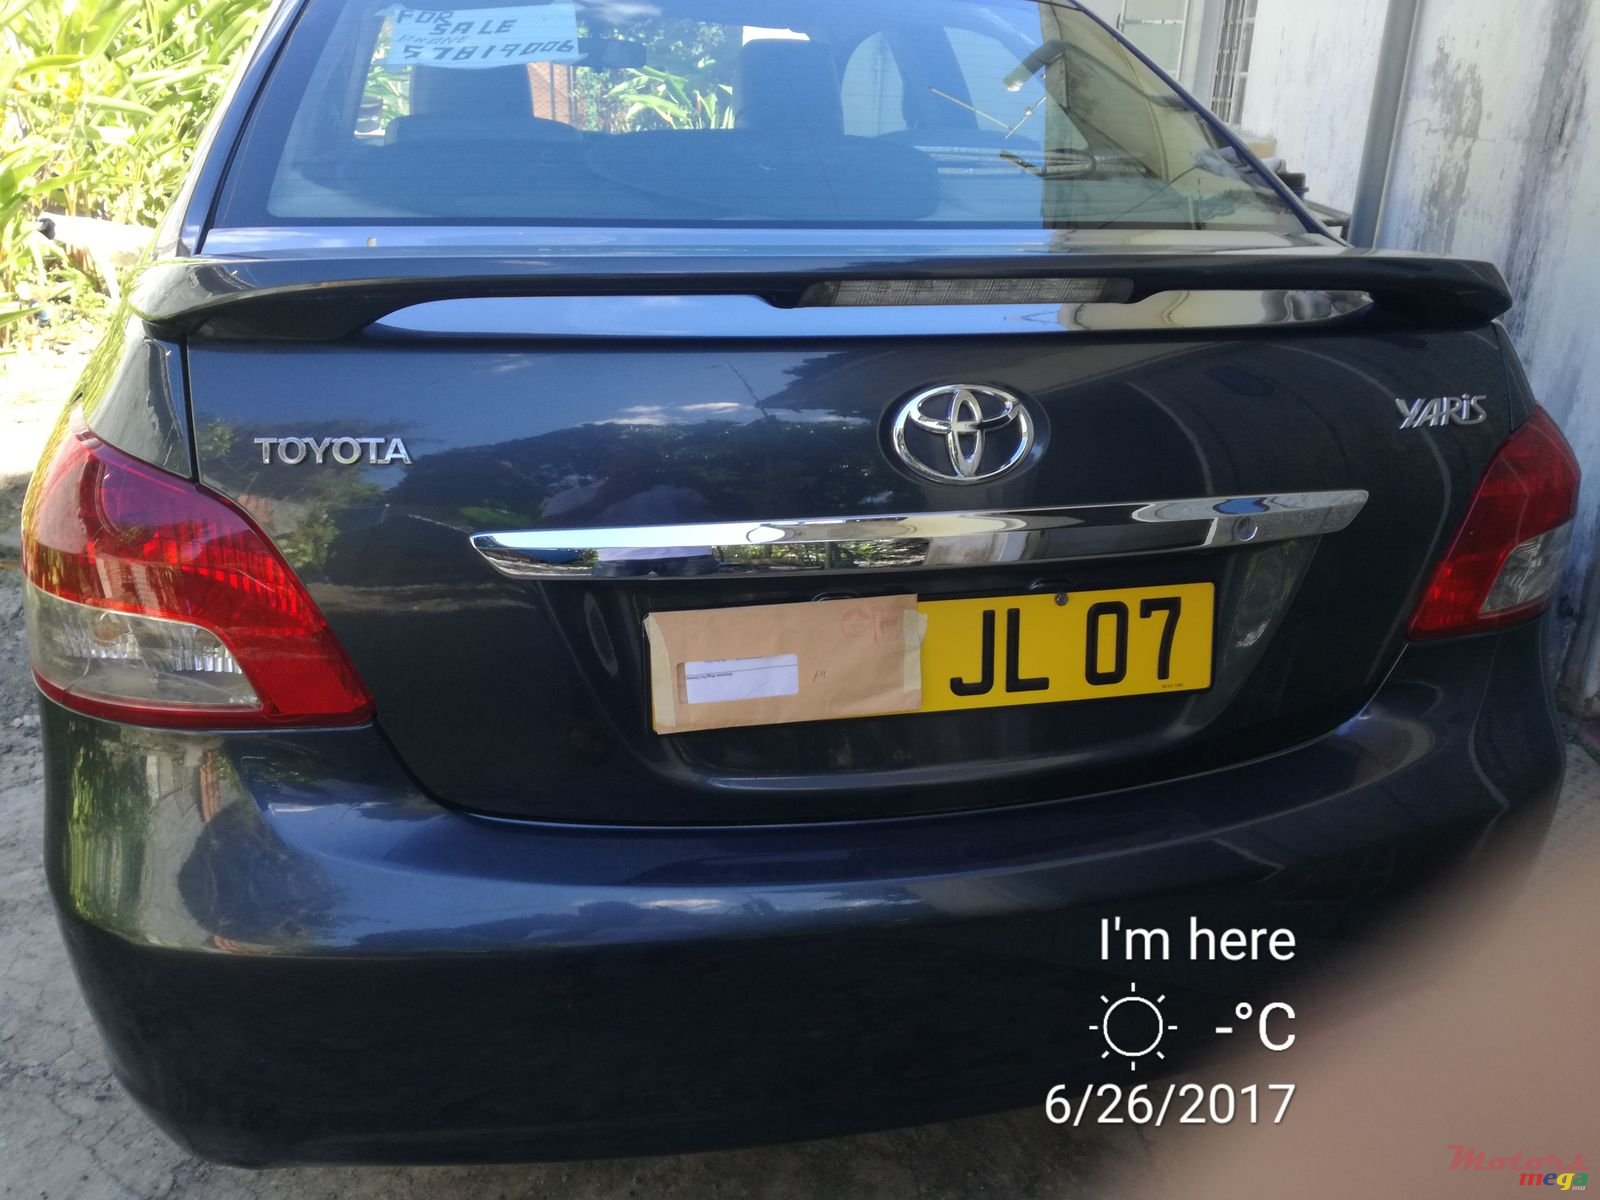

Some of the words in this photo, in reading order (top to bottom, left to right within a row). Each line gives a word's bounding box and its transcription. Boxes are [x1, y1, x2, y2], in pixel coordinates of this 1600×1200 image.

[397, 10, 454, 24] FOR
[429, 19, 517, 35] SALE
[254, 437, 412, 465] TOYOTA
[950, 608, 1049, 696] JL
[1085, 596, 1181, 686] 07
